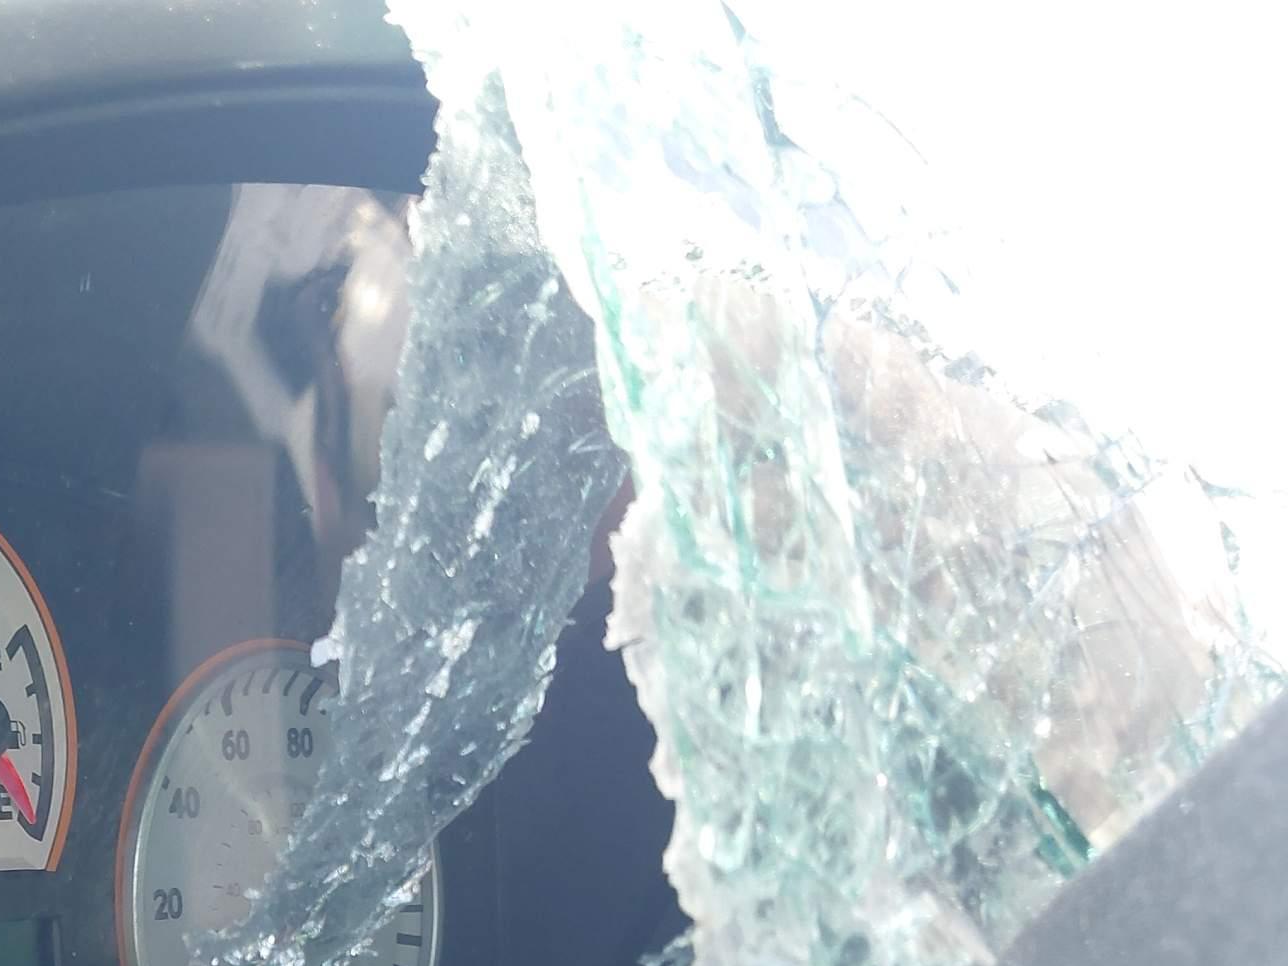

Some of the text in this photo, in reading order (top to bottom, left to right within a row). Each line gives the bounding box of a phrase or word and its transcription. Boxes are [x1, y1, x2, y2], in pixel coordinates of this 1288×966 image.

[222, 730, 249, 760] 60
[287, 728, 312, 758] 80
[169, 787, 200, 819] 40
[153, 888, 183, 920] 20
